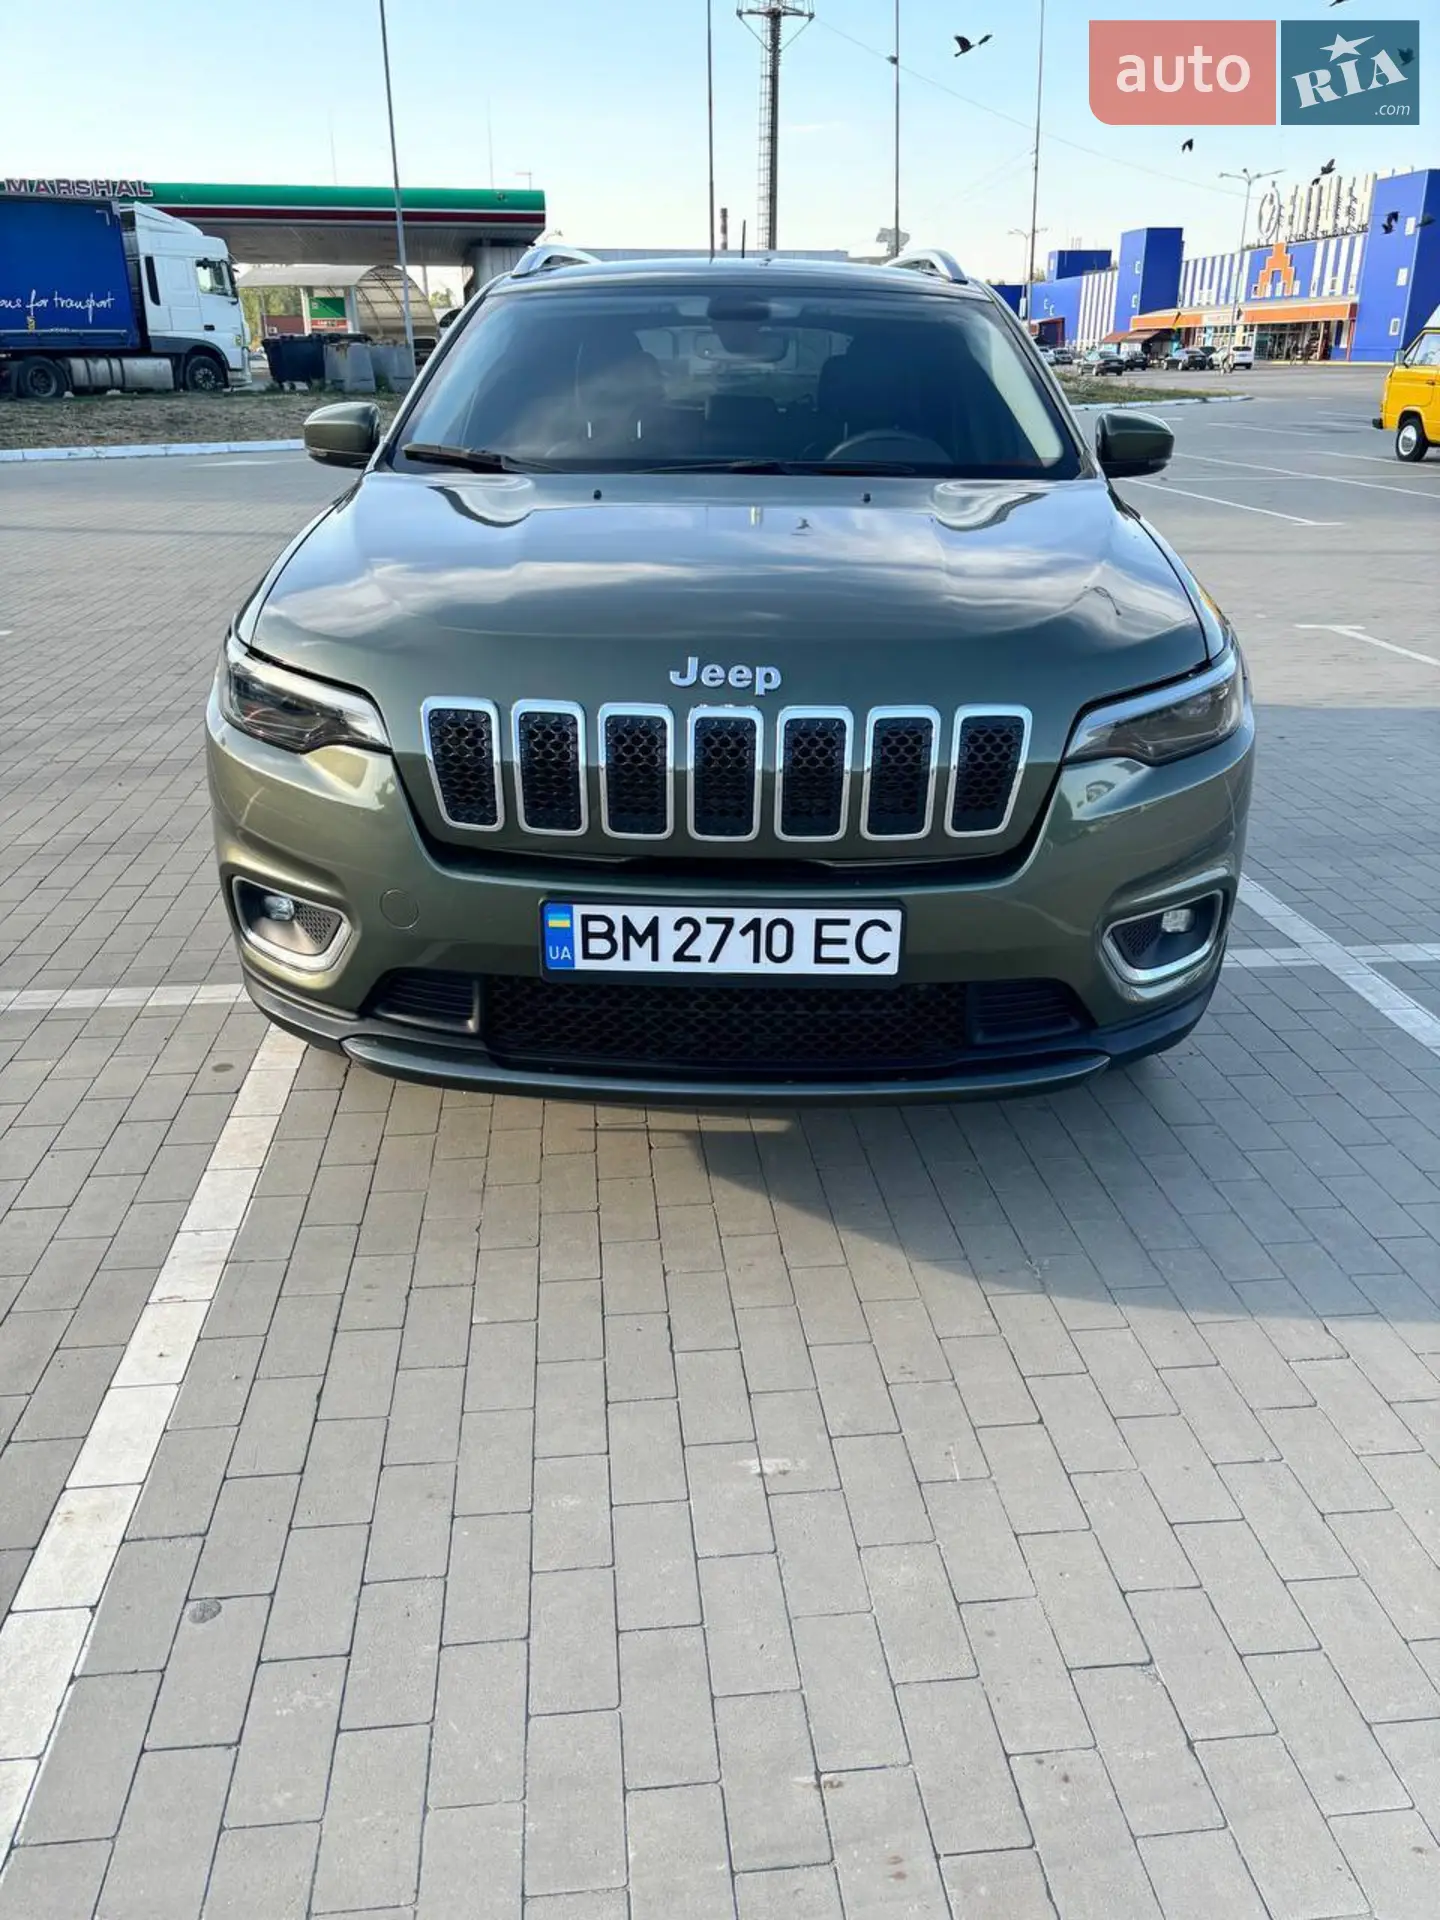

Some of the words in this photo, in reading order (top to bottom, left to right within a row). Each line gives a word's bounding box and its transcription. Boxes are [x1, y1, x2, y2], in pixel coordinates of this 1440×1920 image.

[4, 178, 154, 197] MARSHAL
[26, 289, 49, 316] for
[53, 290, 116, 324] transport
[669, 656, 782, 696] Jeep
[549, 945, 571, 960] UA
[580, 914, 659, 962] BM
[673, 916, 794, 964] 2710
[813, 917, 893, 965] EC
